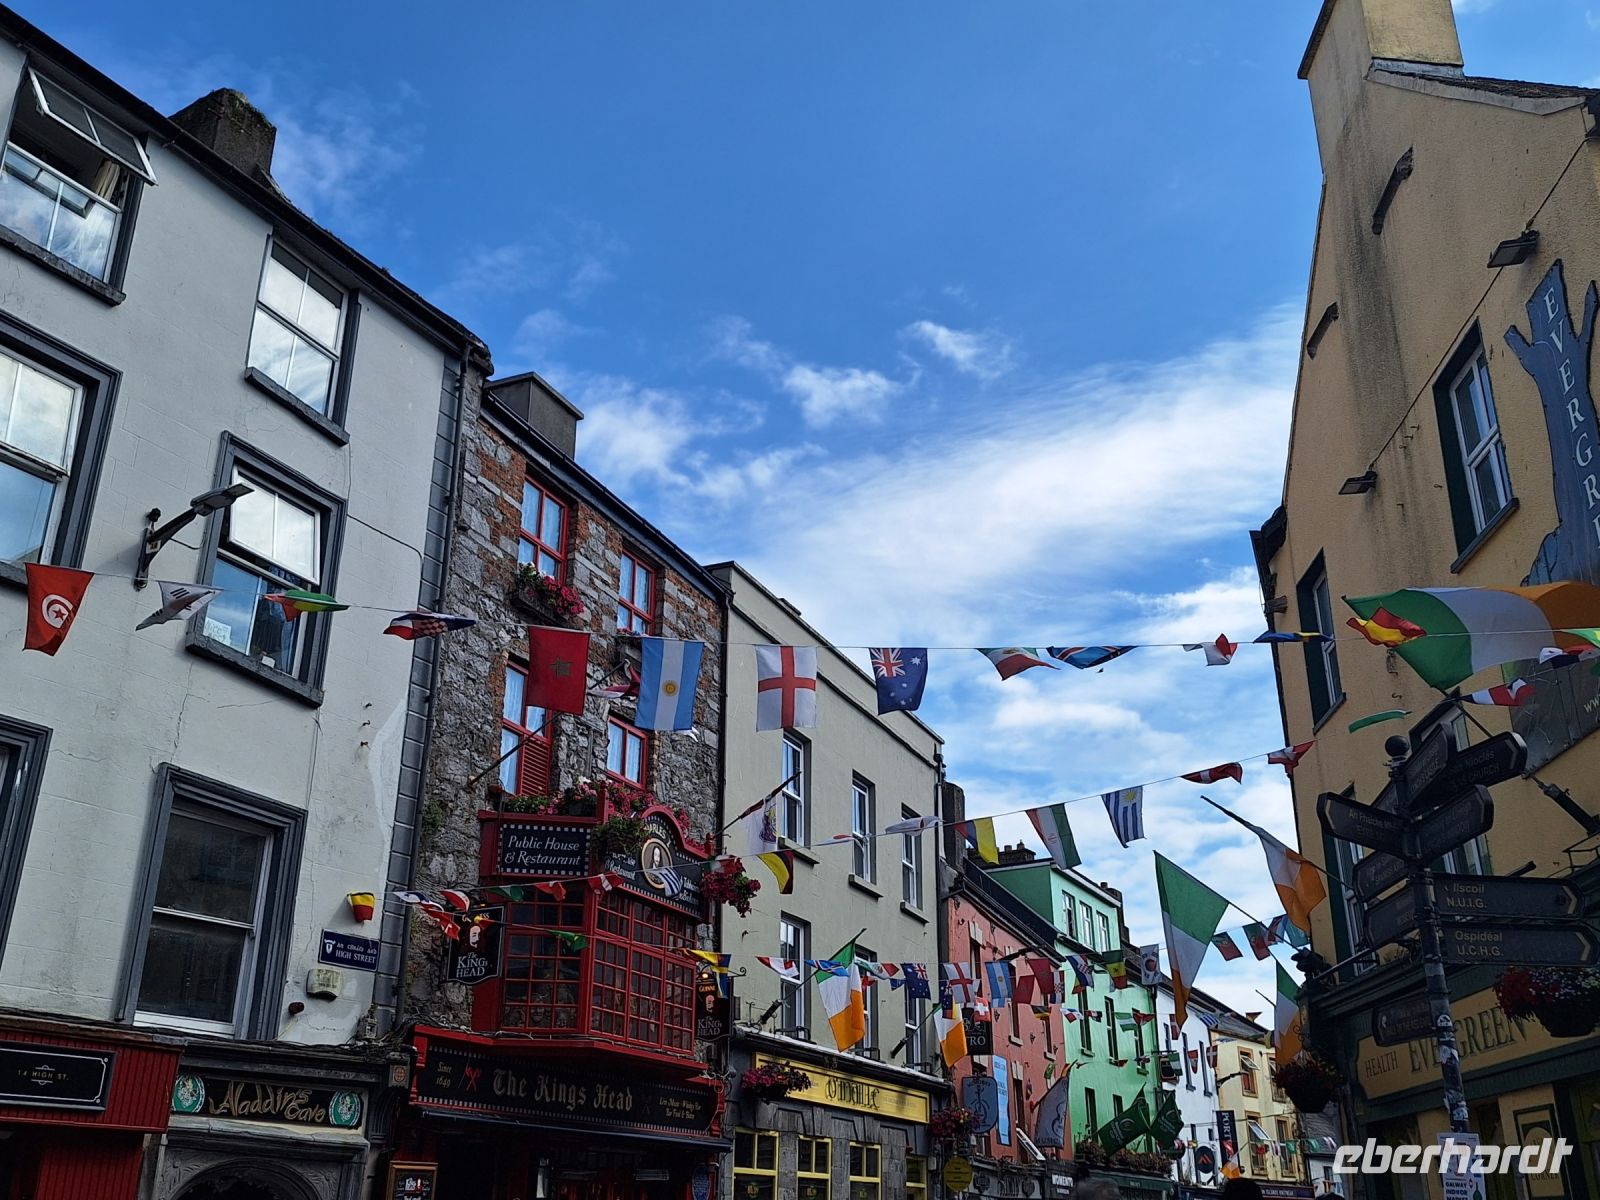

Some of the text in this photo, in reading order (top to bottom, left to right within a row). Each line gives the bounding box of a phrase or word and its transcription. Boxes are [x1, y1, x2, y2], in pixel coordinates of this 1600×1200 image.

[508, 834, 580, 851] Public House
[504, 850, 581, 866] & Restaurant
[1455, 930, 1503, 943] Ospidéal
[335, 949, 376, 964] HIGH STREET
[456, 966, 485, 978] HEAD
[1365, 1051, 1399, 1079] HEALTH
[1408, 1007, 1527, 1074] EVEGREEN
[32, 1070, 53, 1079] HIGH
[493, 1068, 633, 1111] The Kings Head
[208, 1080, 312, 1117] Aladdin's
